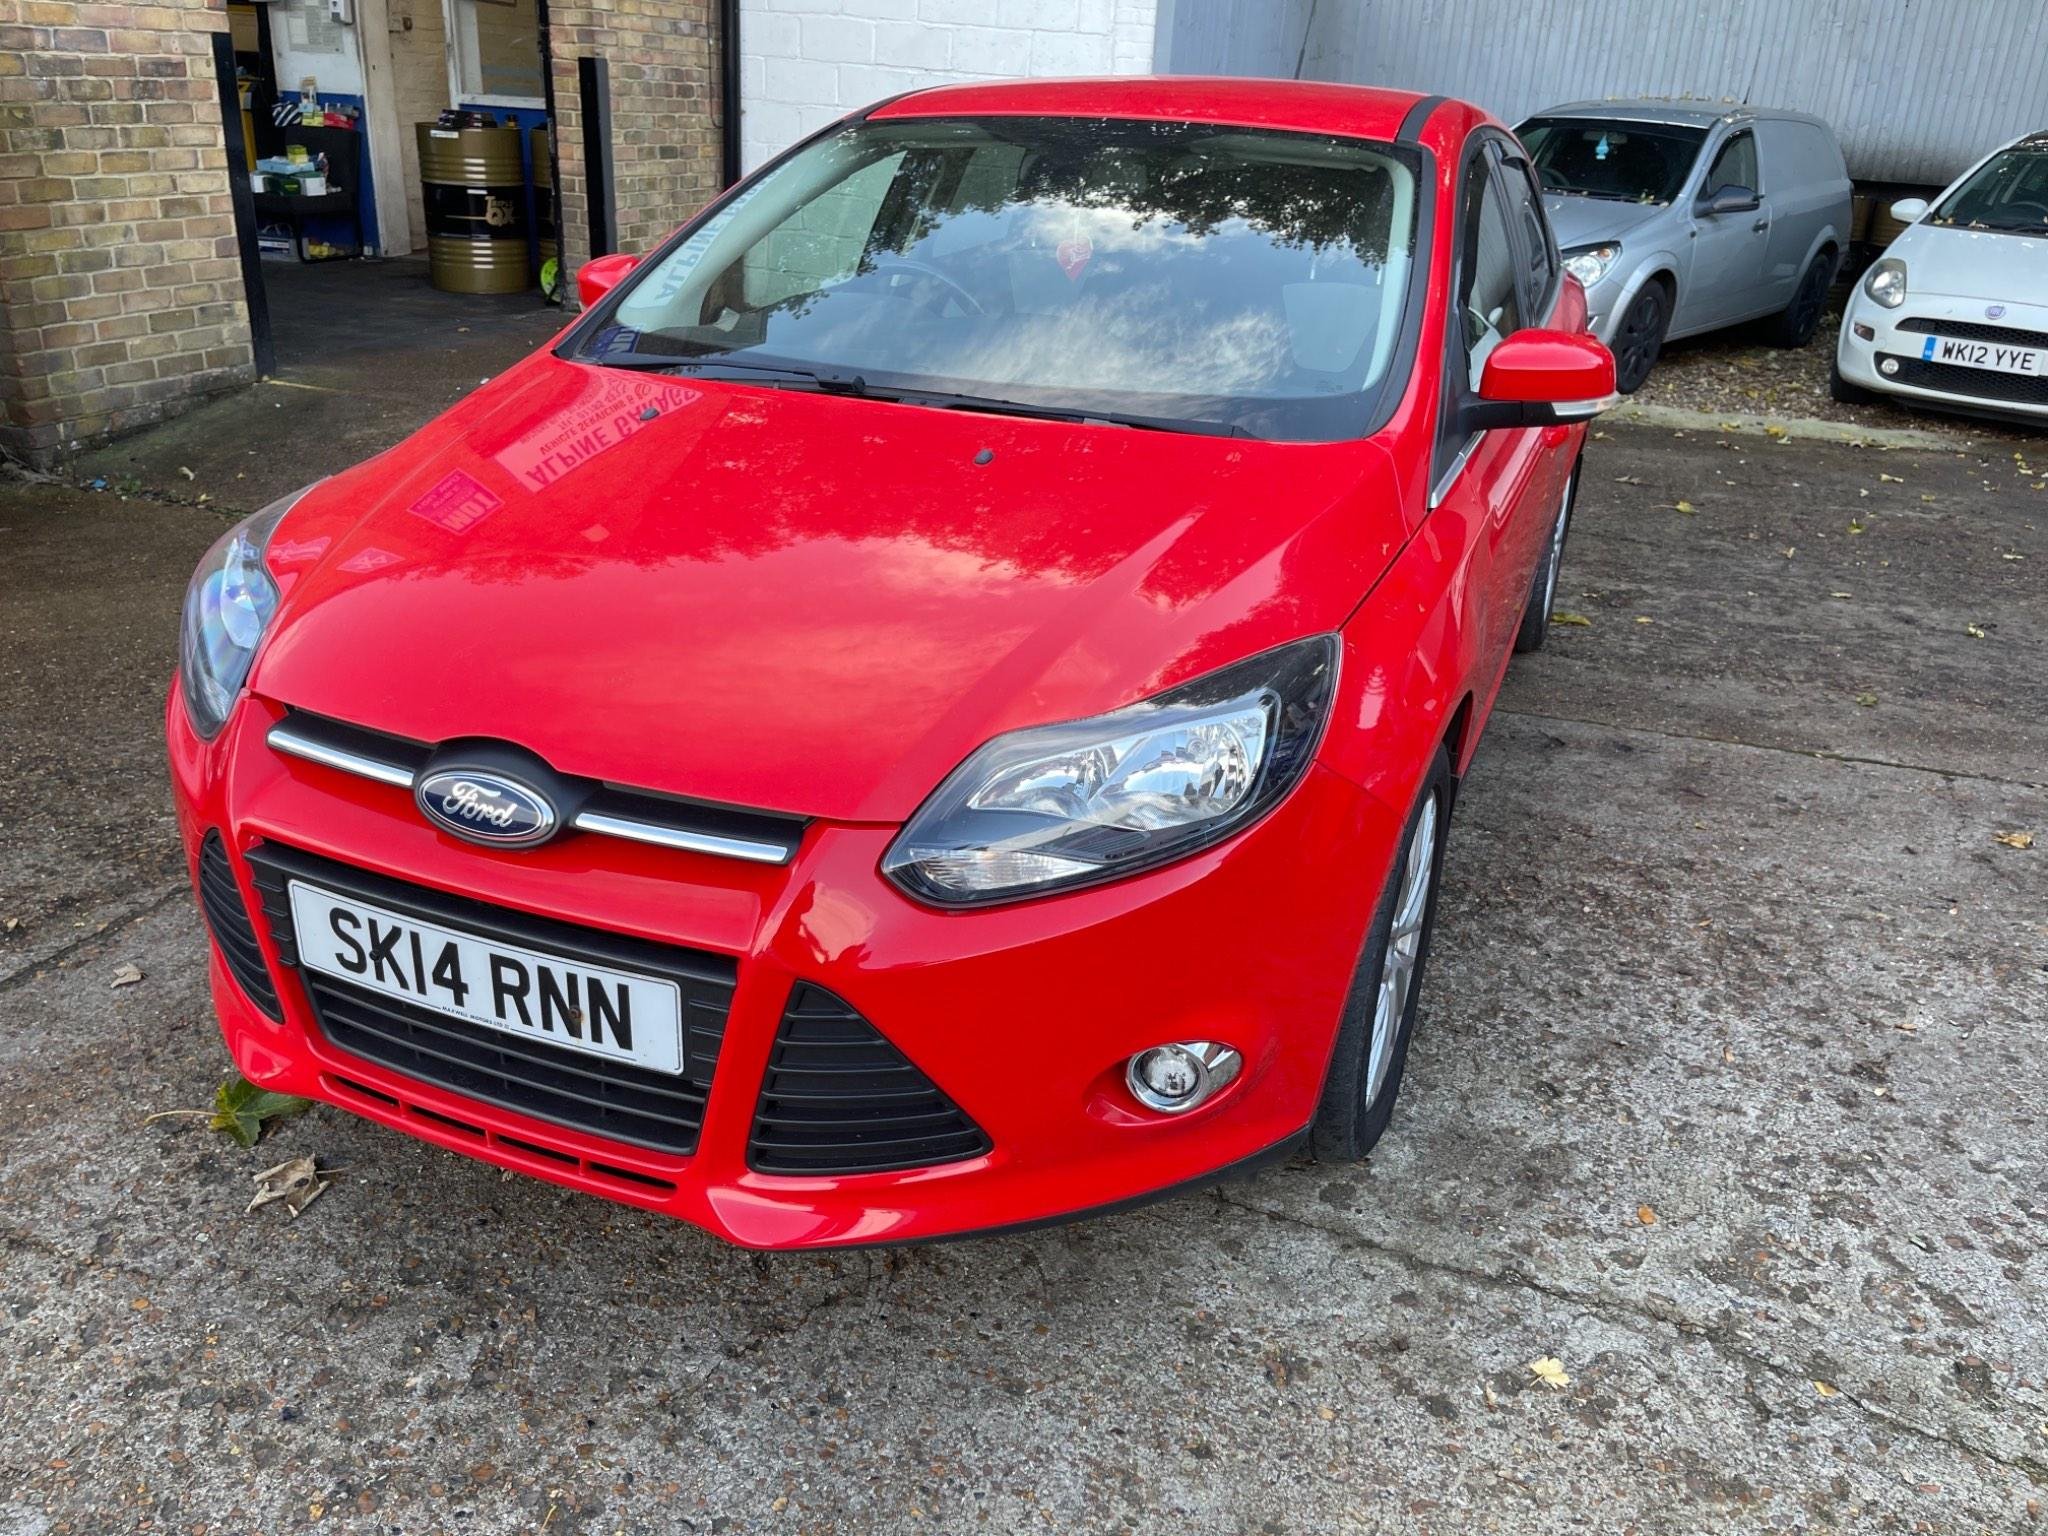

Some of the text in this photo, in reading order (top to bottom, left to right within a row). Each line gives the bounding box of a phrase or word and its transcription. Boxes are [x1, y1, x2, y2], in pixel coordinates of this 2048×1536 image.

[1942, 341, 2036, 371] WK12 YYE
[442, 781, 515, 828] Ford
[329, 907, 634, 1052] SK14 RNN
